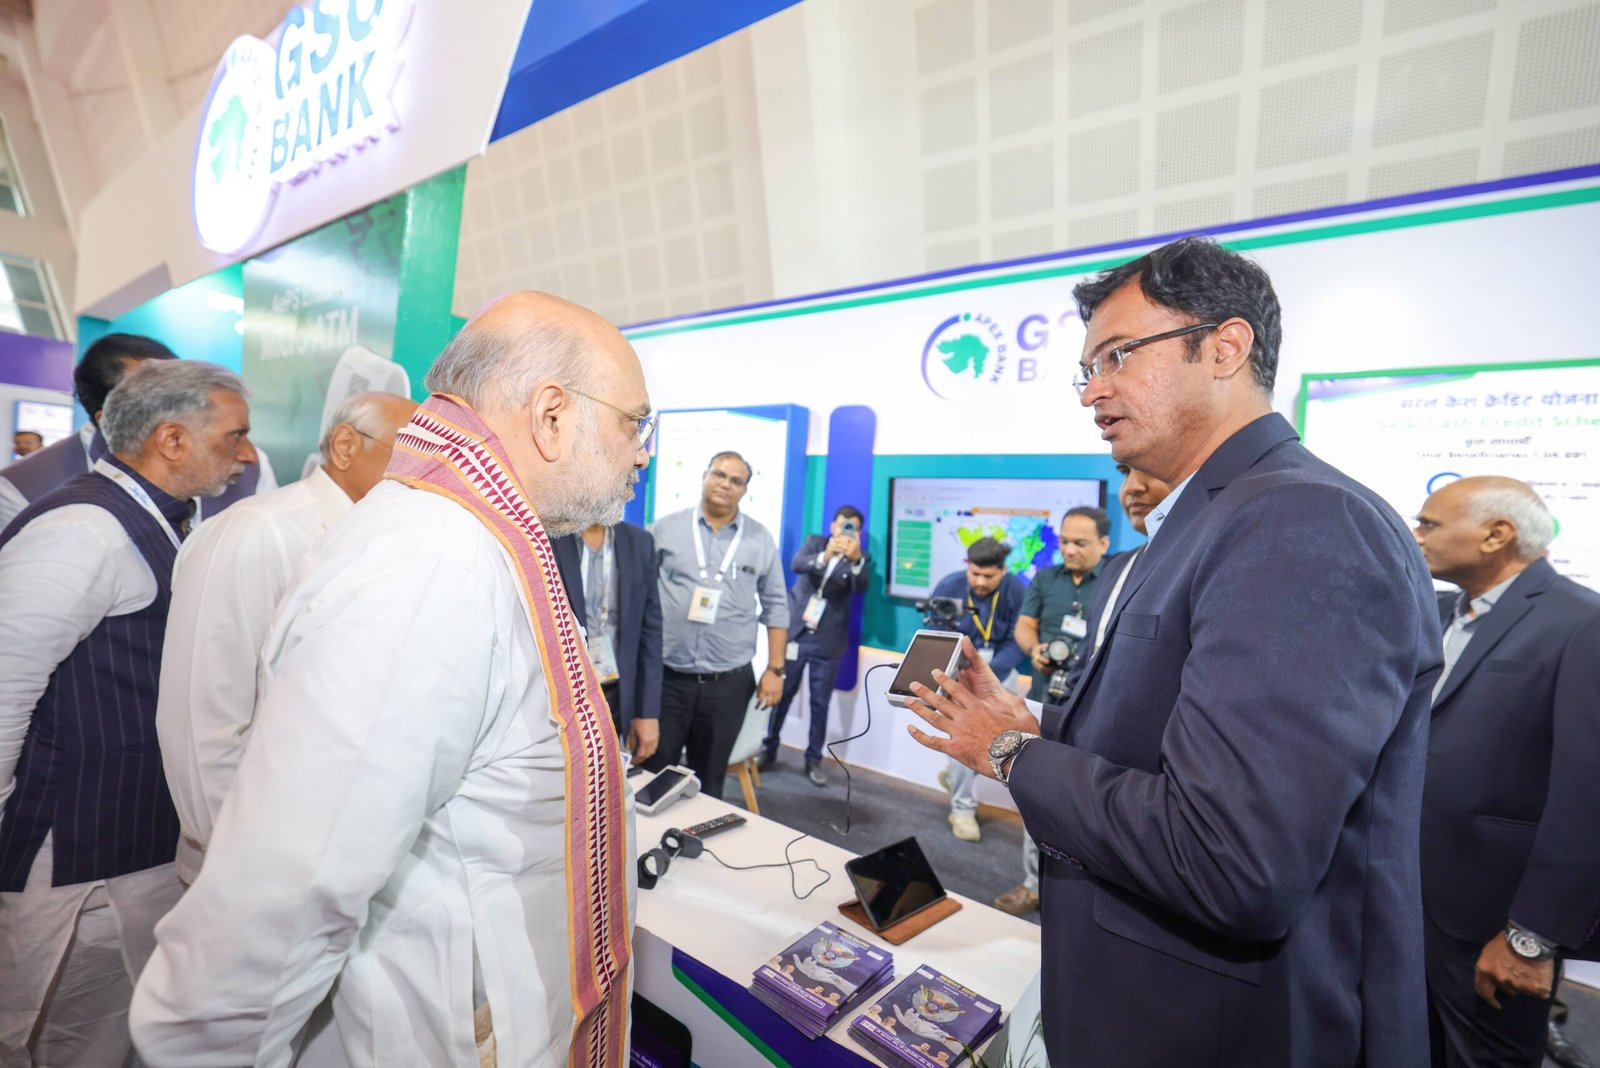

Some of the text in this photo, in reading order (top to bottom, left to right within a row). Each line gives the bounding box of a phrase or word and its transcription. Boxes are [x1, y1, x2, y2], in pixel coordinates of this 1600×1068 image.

[270, 50, 375, 174] BANK
[974, 313, 1008, 385] APEX BANK
